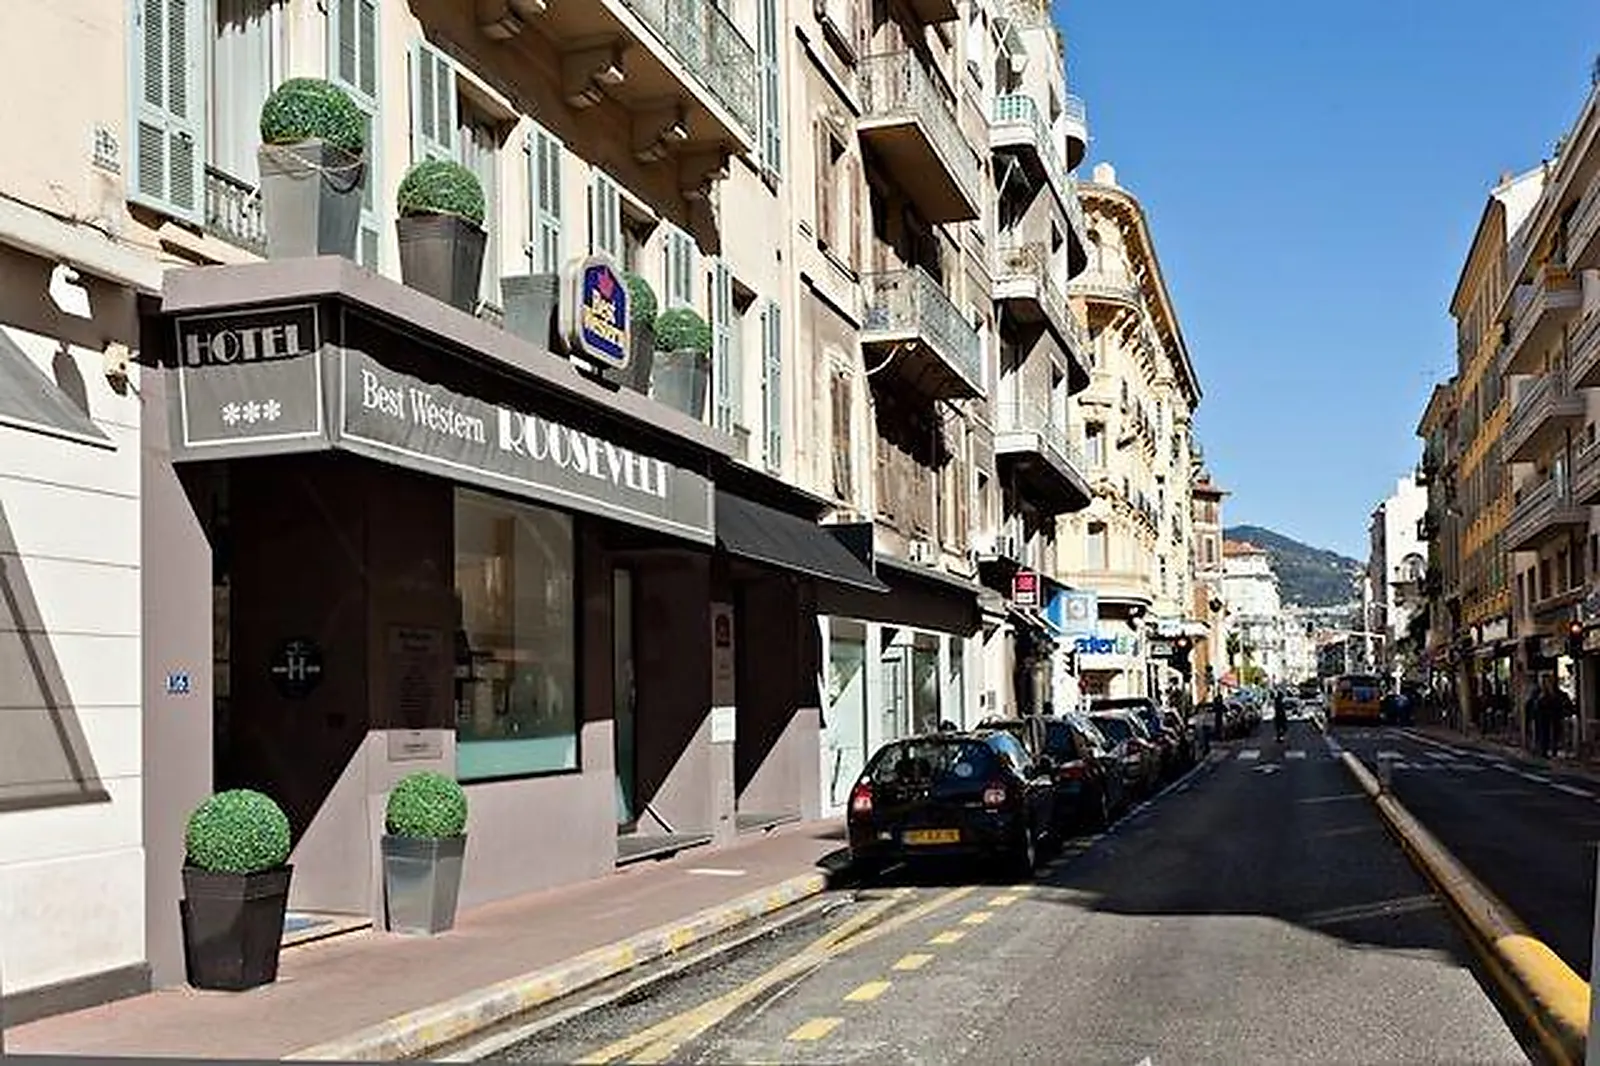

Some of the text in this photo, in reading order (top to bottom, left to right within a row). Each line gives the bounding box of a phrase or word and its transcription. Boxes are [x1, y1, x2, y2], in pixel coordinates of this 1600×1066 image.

[186, 324, 304, 366] HOTEL
[361, 368, 405, 420] Best
[409, 387, 487, 444] Western
